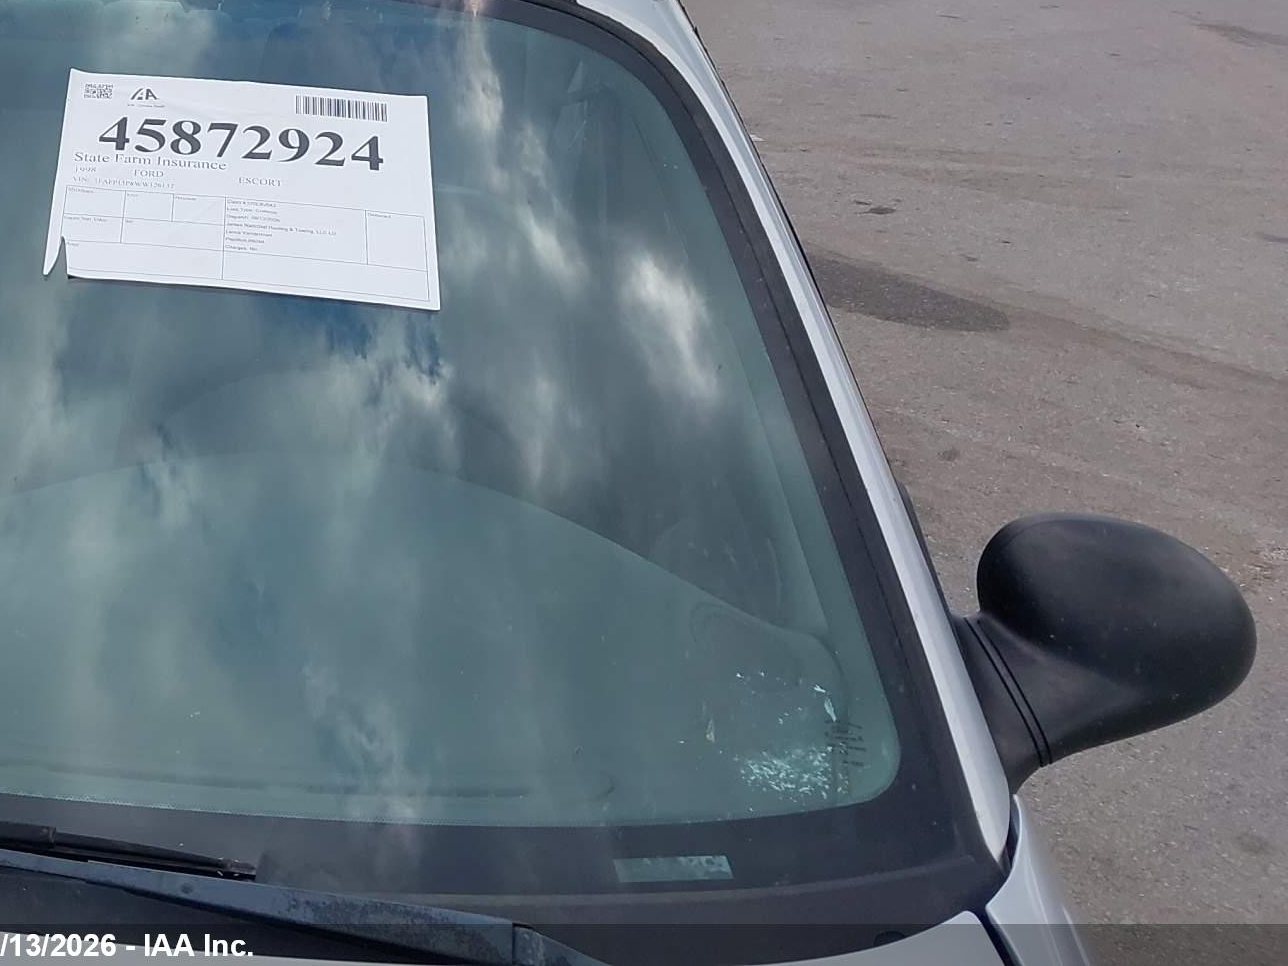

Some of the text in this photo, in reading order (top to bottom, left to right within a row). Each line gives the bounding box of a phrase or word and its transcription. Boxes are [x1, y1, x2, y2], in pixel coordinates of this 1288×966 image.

[99, 116, 384, 171] 45872924
[74, 151, 227, 171] State Farm Insurance
[134, 169, 164, 178] FORD
[239, 177, 282, 187] ESCORT
